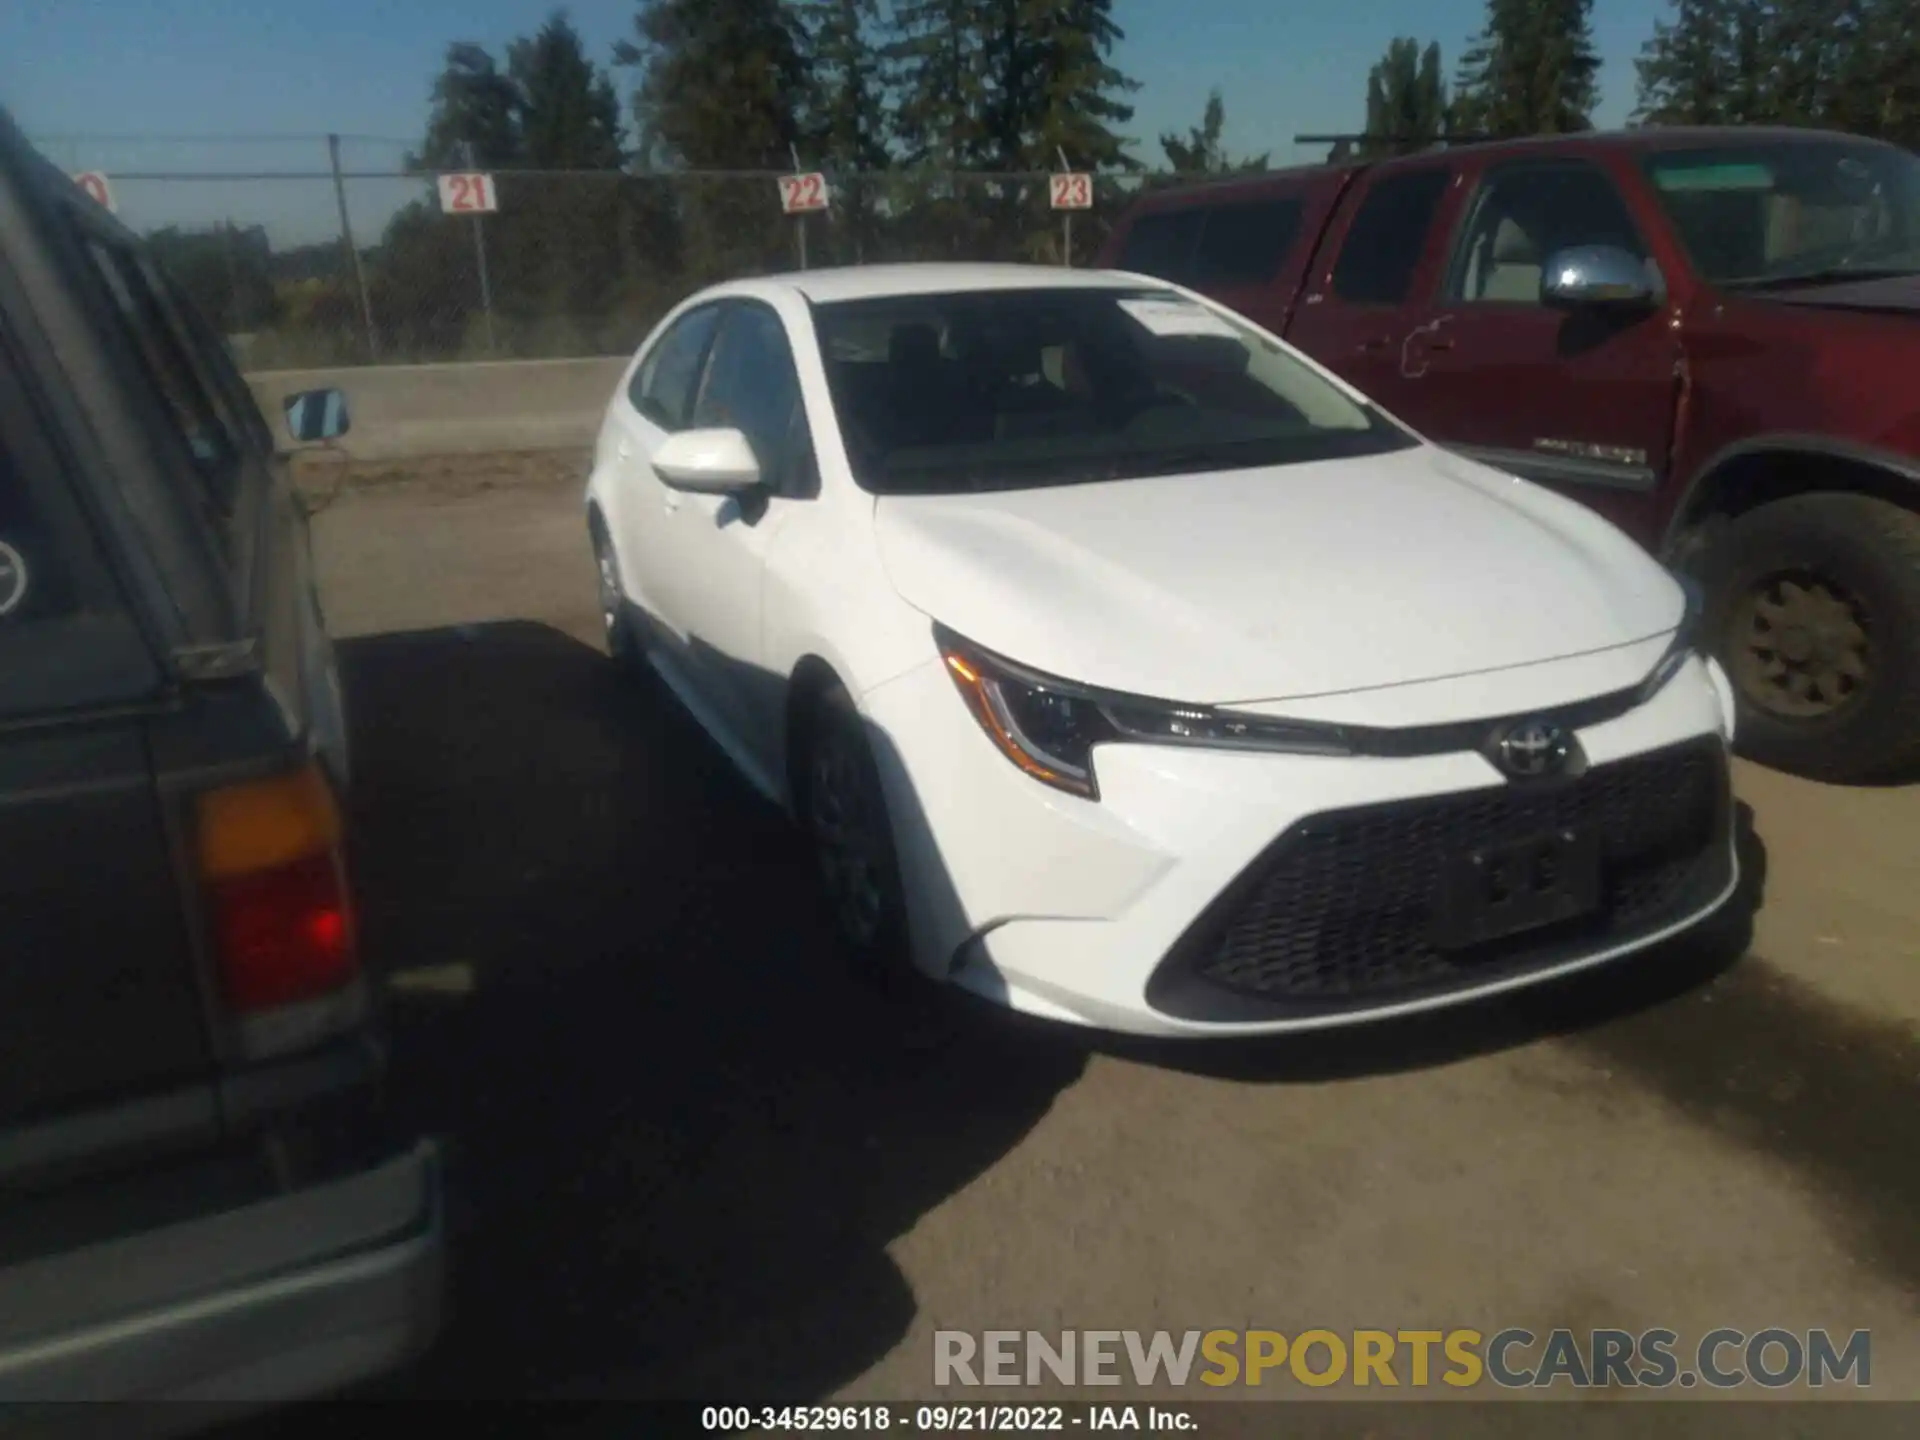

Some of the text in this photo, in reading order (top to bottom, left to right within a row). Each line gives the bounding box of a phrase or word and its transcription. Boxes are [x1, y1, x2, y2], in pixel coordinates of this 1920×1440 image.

[449, 175, 485, 209] 21
[784, 175, 823, 209] 22
[1055, 175, 1088, 207] 23
